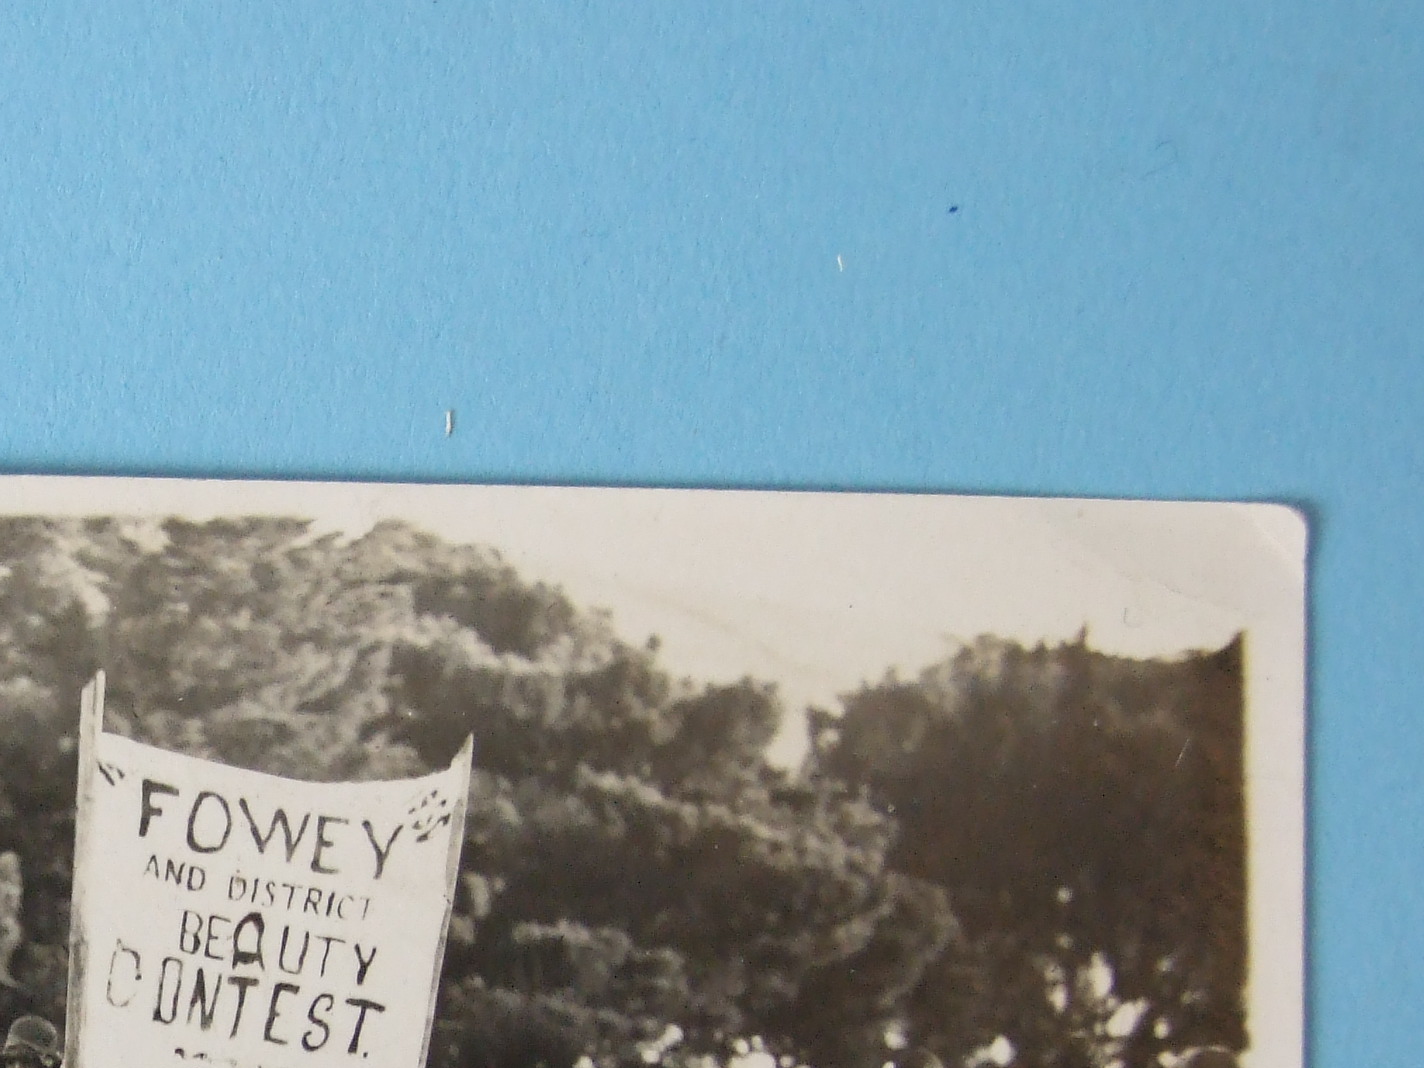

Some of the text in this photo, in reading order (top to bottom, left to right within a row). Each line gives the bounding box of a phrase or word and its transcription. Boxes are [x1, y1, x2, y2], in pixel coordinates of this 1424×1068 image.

[139, 779, 403, 879] FOWEY
[144, 854, 372, 921] AND DISTRICT
[179, 911, 377, 986] BEAUTY
